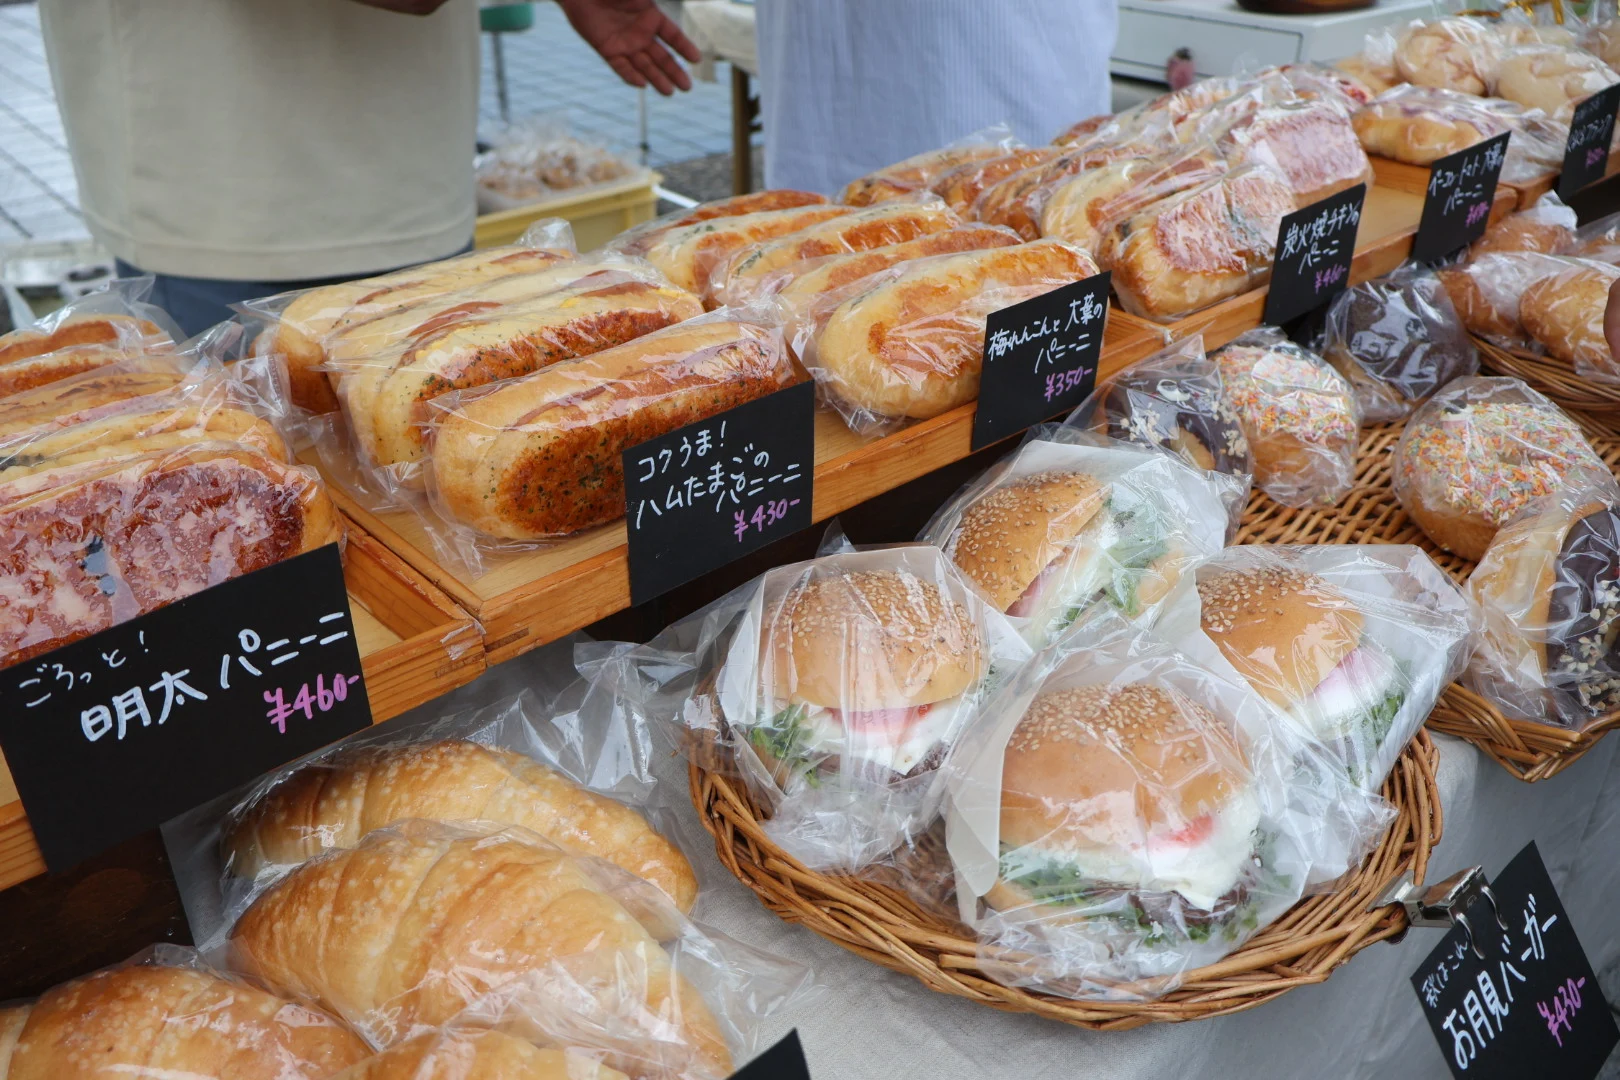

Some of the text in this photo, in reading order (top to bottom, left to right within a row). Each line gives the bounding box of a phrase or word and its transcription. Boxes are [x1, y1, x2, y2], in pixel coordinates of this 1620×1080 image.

[1298, 240, 1339, 275] パニーニ
[1034, 333, 1091, 374] パニーニ
[1044, 366, 1093, 402] ¥350-
[638, 420, 727, 482] コクうま!
[636, 443, 770, 530] ハムたまごの
[715, 463, 802, 513] パニーニ
[733, 498, 801, 543] ¥430-
[19, 630, 149, 707] ごろっと!
[264, 673, 360, 734] ¥460-
[1442, 893, 1558, 1070] お月見バーガー
[1537, 976, 1586, 1048] ¥430-
